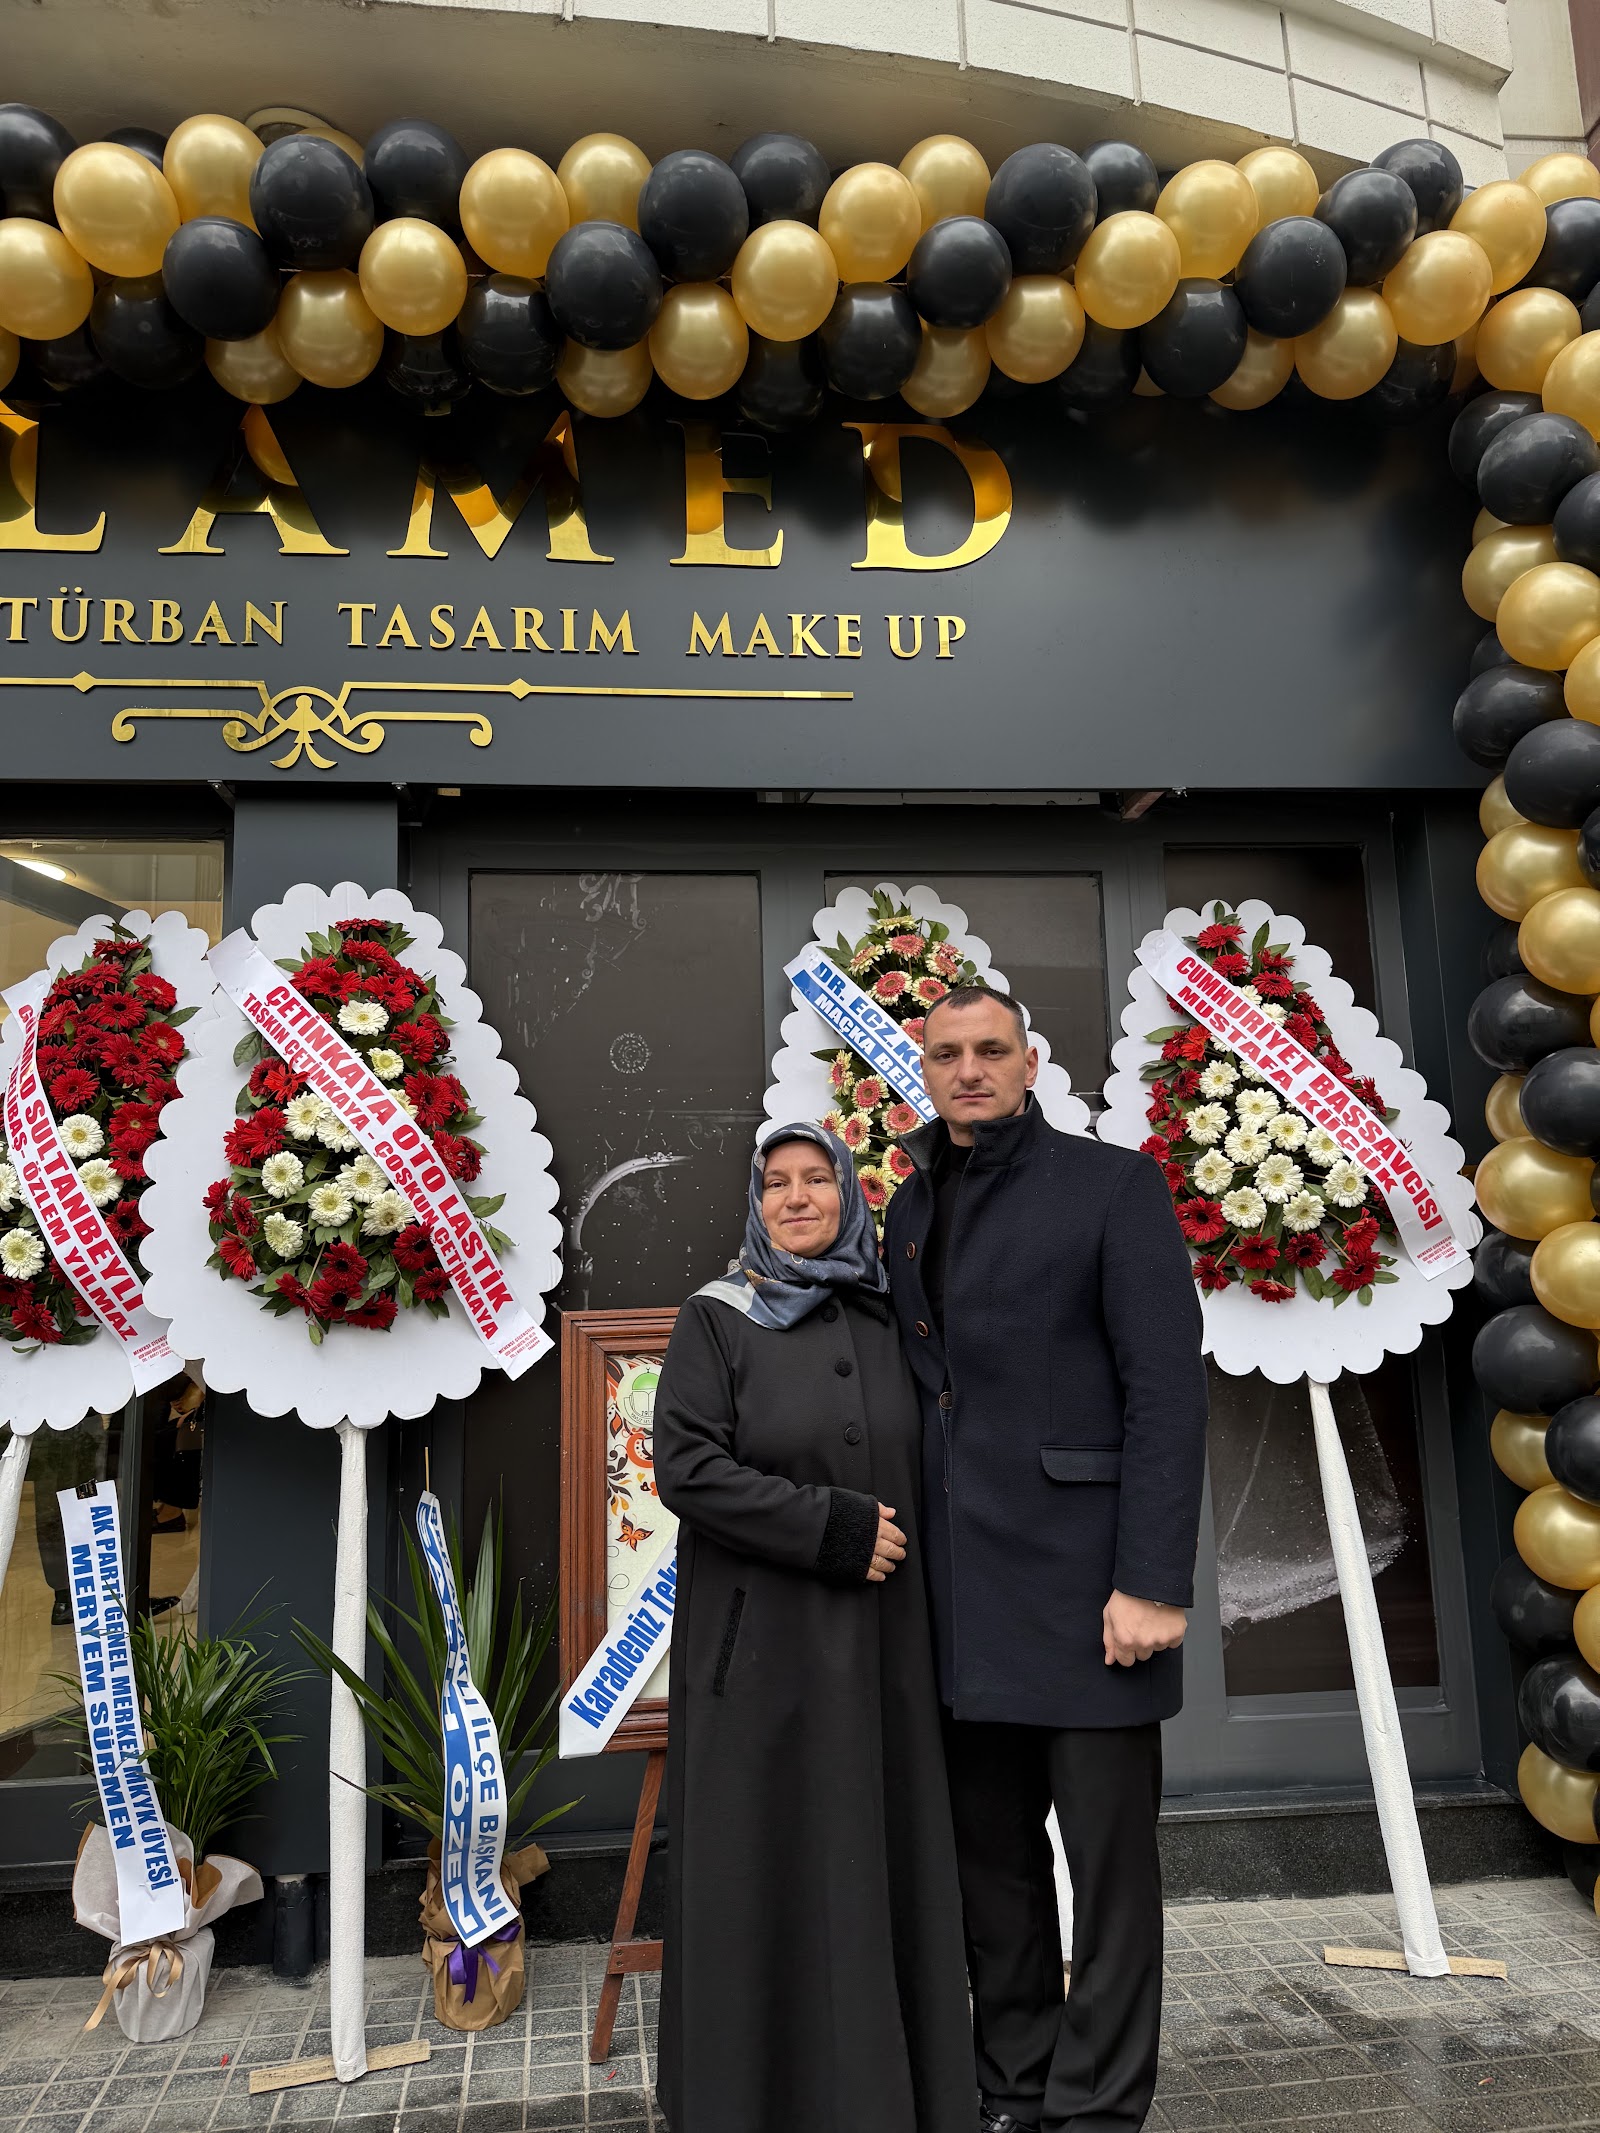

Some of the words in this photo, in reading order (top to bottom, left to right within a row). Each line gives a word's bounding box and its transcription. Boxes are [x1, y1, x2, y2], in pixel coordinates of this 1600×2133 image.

[0, 586, 288, 645] TÜRBAN
[338, 603, 640, 655] TASARIM
[685, 611, 863, 657] MAKE
[885, 615, 967, 658] UP
[812, 961, 846, 1001] DR.
[814, 994, 876, 1055] MAÇKA
[1176, 957, 1317, 1075] CUMHURİYET
[1308, 1073, 1444, 1231] BAŞSAVCISI
[1177, 985, 1294, 1092] MUSTAFA
[1295, 1090, 1399, 1194] KÜÇÜK
[242, 993, 291, 1045] TAŞKIN
[283, 1039, 370, 1132] ÇETİNKAYA
[432, 1226, 499, 1340] ÇETİNKAYA
[264, 985, 397, 1126] ÇETİNKAYA
[392, 1124, 447, 1193] OTO
[438, 1193, 514, 1313] LASTİK
[23, 1160, 72, 1246] ÖZLEM
[63, 1246, 139, 1342] YILMAZ
[90, 1505, 116, 1535] AK
[96, 1537, 124, 1601] PARTİ
[104, 1606, 129, 1672] GENEL
[567, 1607, 666, 1730] Karadeniz
[640, 1556, 677, 1617] Tek
[71, 1543, 106, 1694] MERYEM
[90, 1702, 136, 1850] SÜRMEN
[122, 1764, 159, 1826] MKYK
[471, 1717, 500, 1802] İLÇE
[140, 1828, 179, 1891] ÜYESİ
[447, 1763, 479, 1935] ÖZEN
[471, 1814, 509, 1922] BAŞKANI
